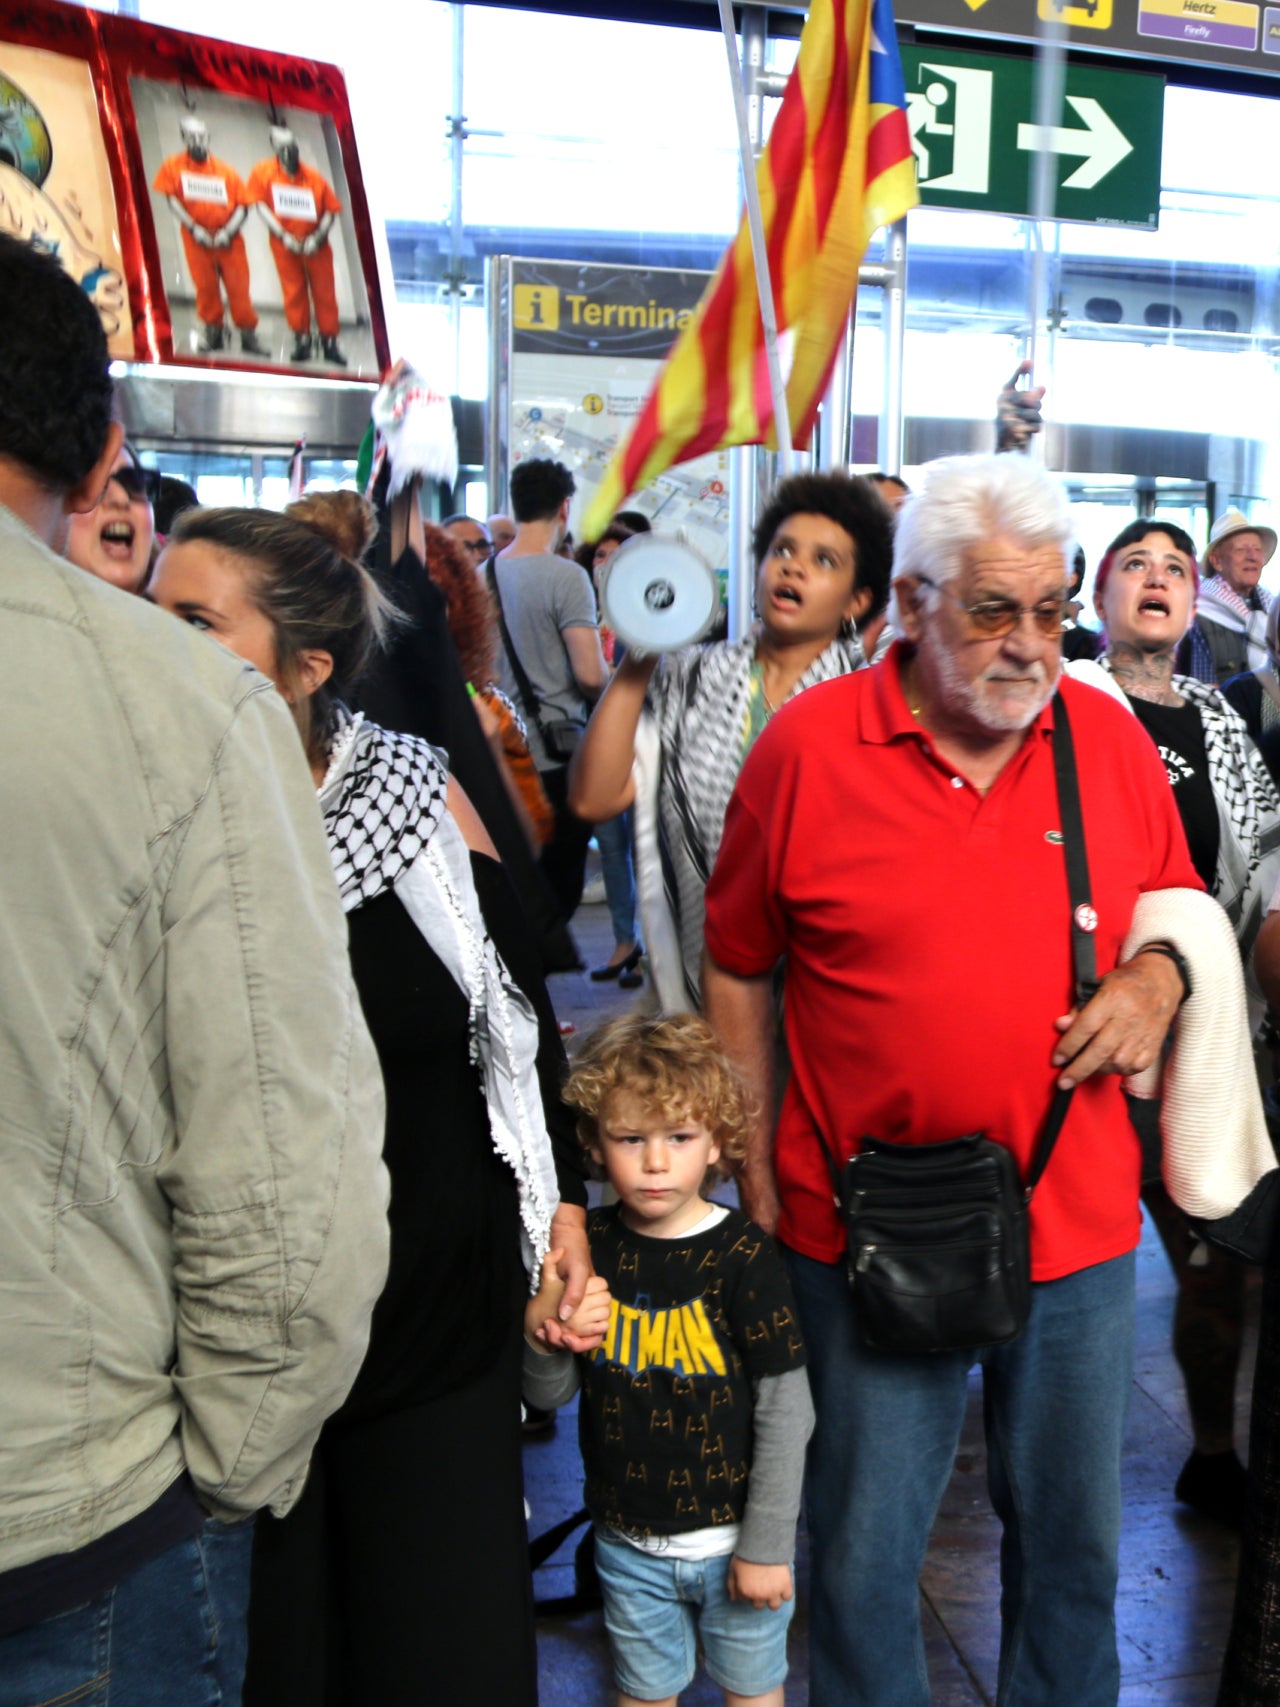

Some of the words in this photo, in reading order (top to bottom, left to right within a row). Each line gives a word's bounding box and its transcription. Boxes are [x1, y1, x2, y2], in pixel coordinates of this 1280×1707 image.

[1184, 24, 1211, 38] Firefly
[565, 294, 696, 331] Termina
[590, 1297, 727, 1376] ATMAN
